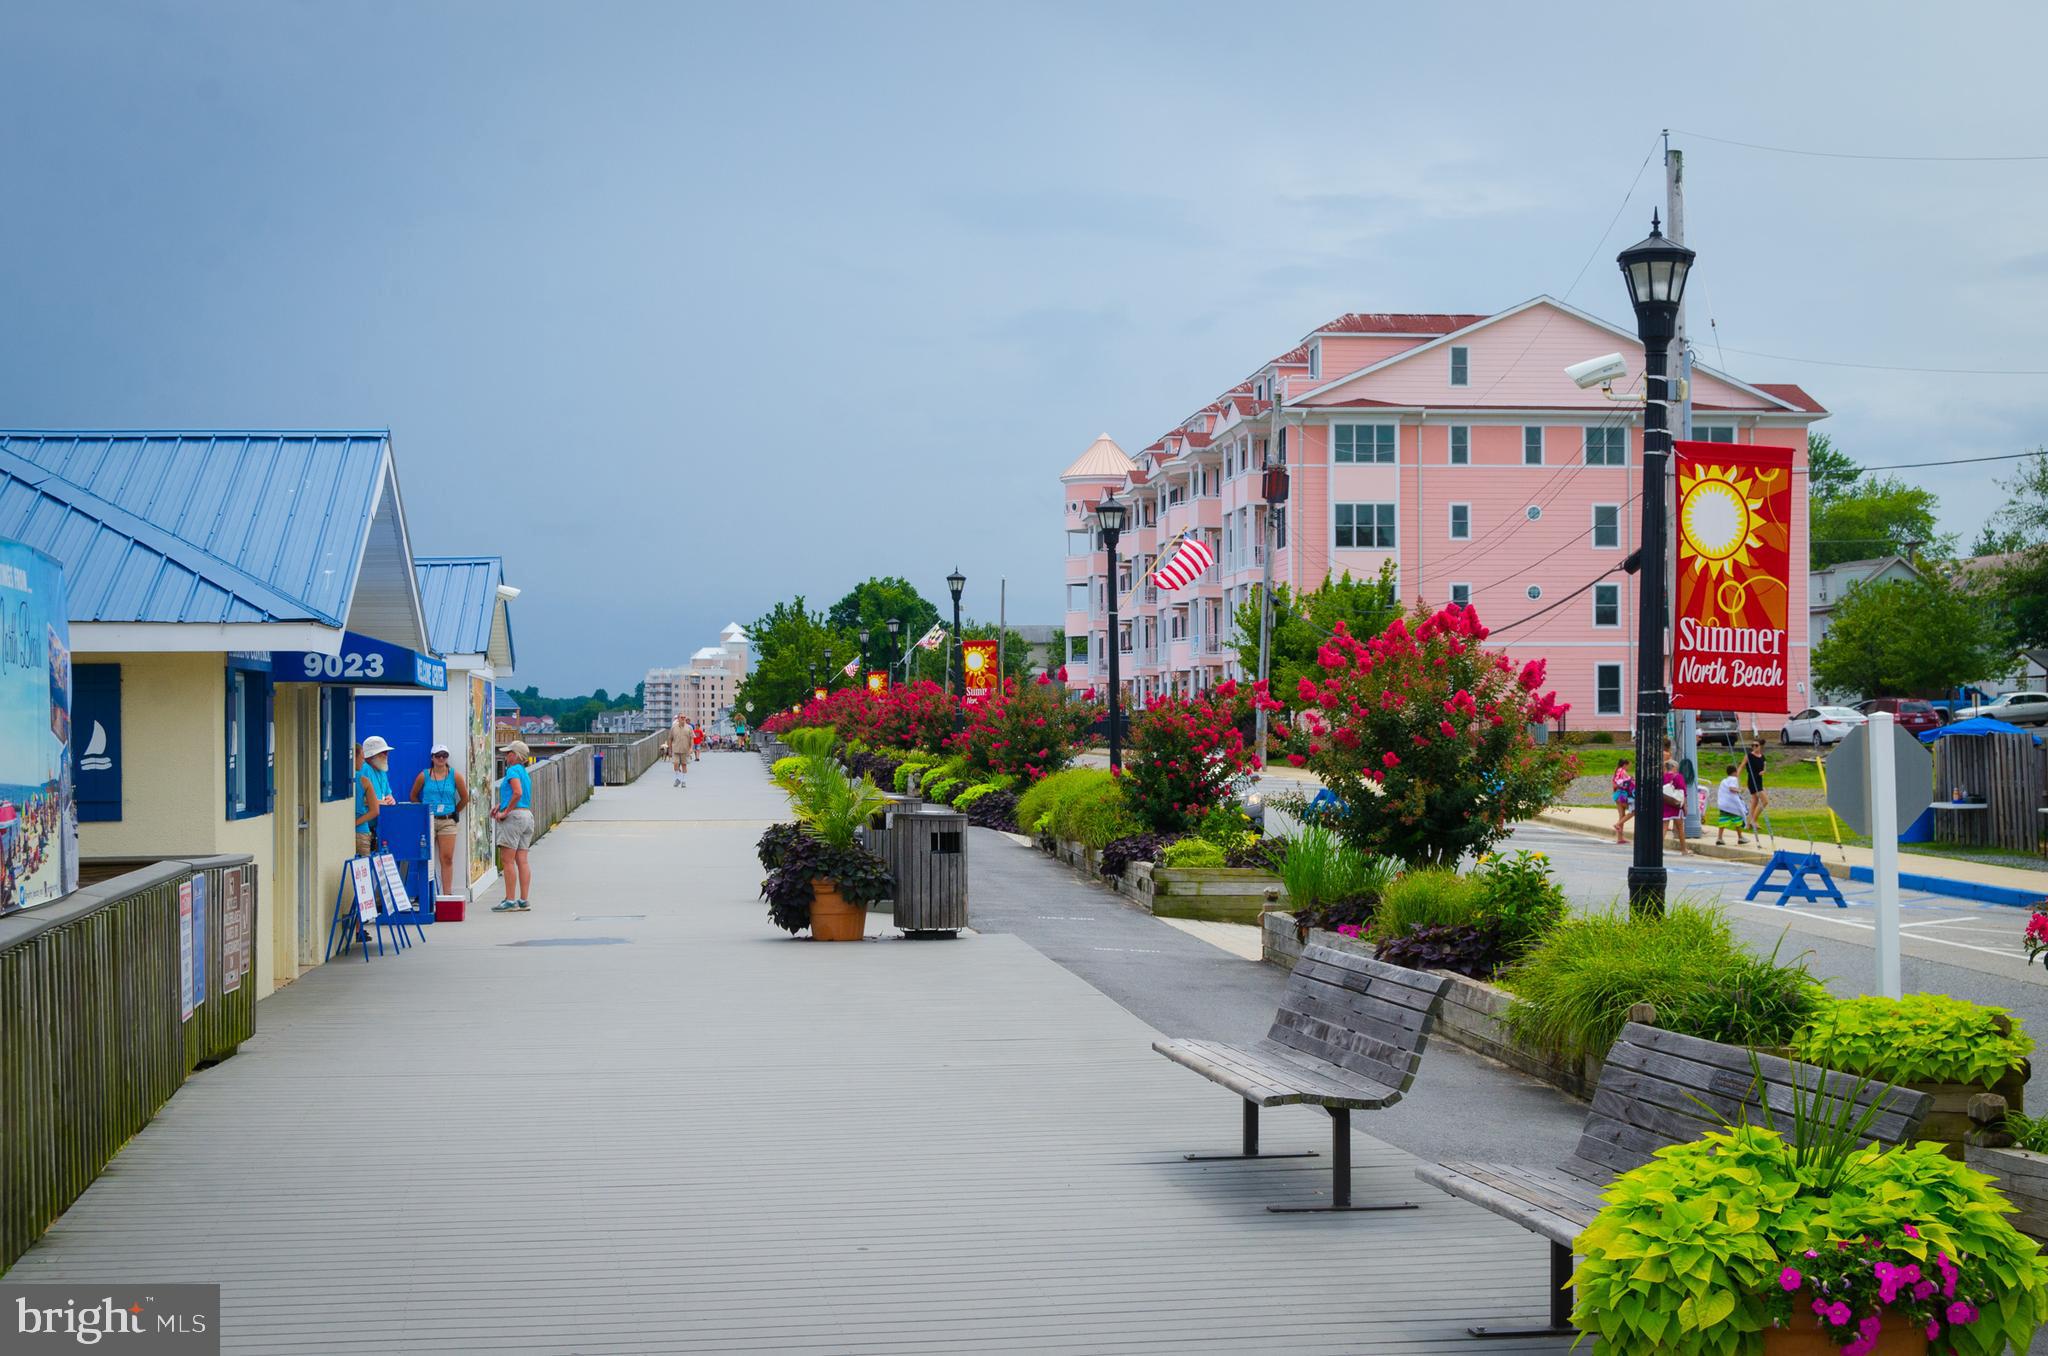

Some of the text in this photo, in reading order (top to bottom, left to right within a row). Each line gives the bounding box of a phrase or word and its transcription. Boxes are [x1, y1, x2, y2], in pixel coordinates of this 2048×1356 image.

[1680, 617, 1785, 655] Summer
[303, 652, 385, 678] 9023
[1678, 656, 1784, 687] North Beach
